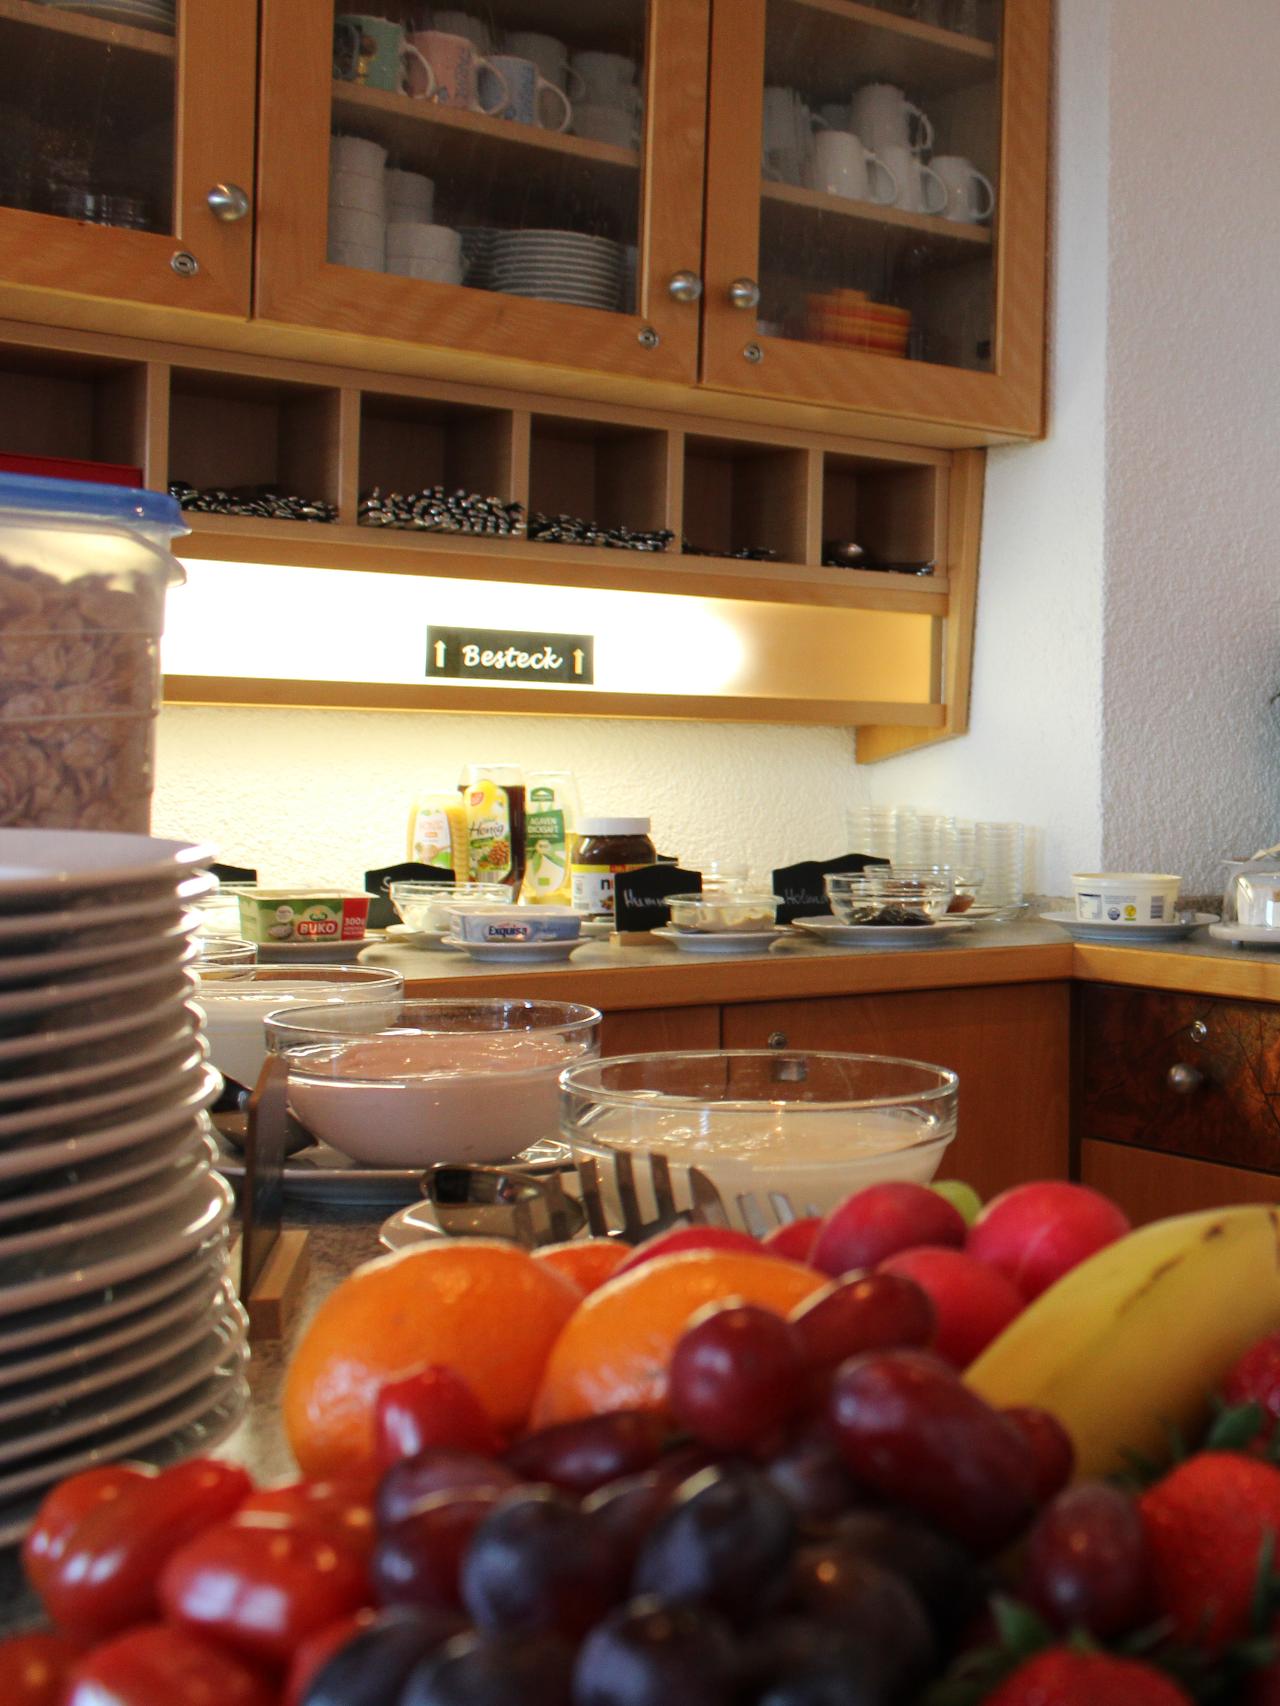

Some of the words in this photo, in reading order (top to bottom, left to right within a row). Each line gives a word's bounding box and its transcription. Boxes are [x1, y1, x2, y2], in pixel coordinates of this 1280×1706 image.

[462, 645, 563, 669] Besteck
[299, 923, 336, 934] BUKO
[488, 925, 528, 938] Exquisa
